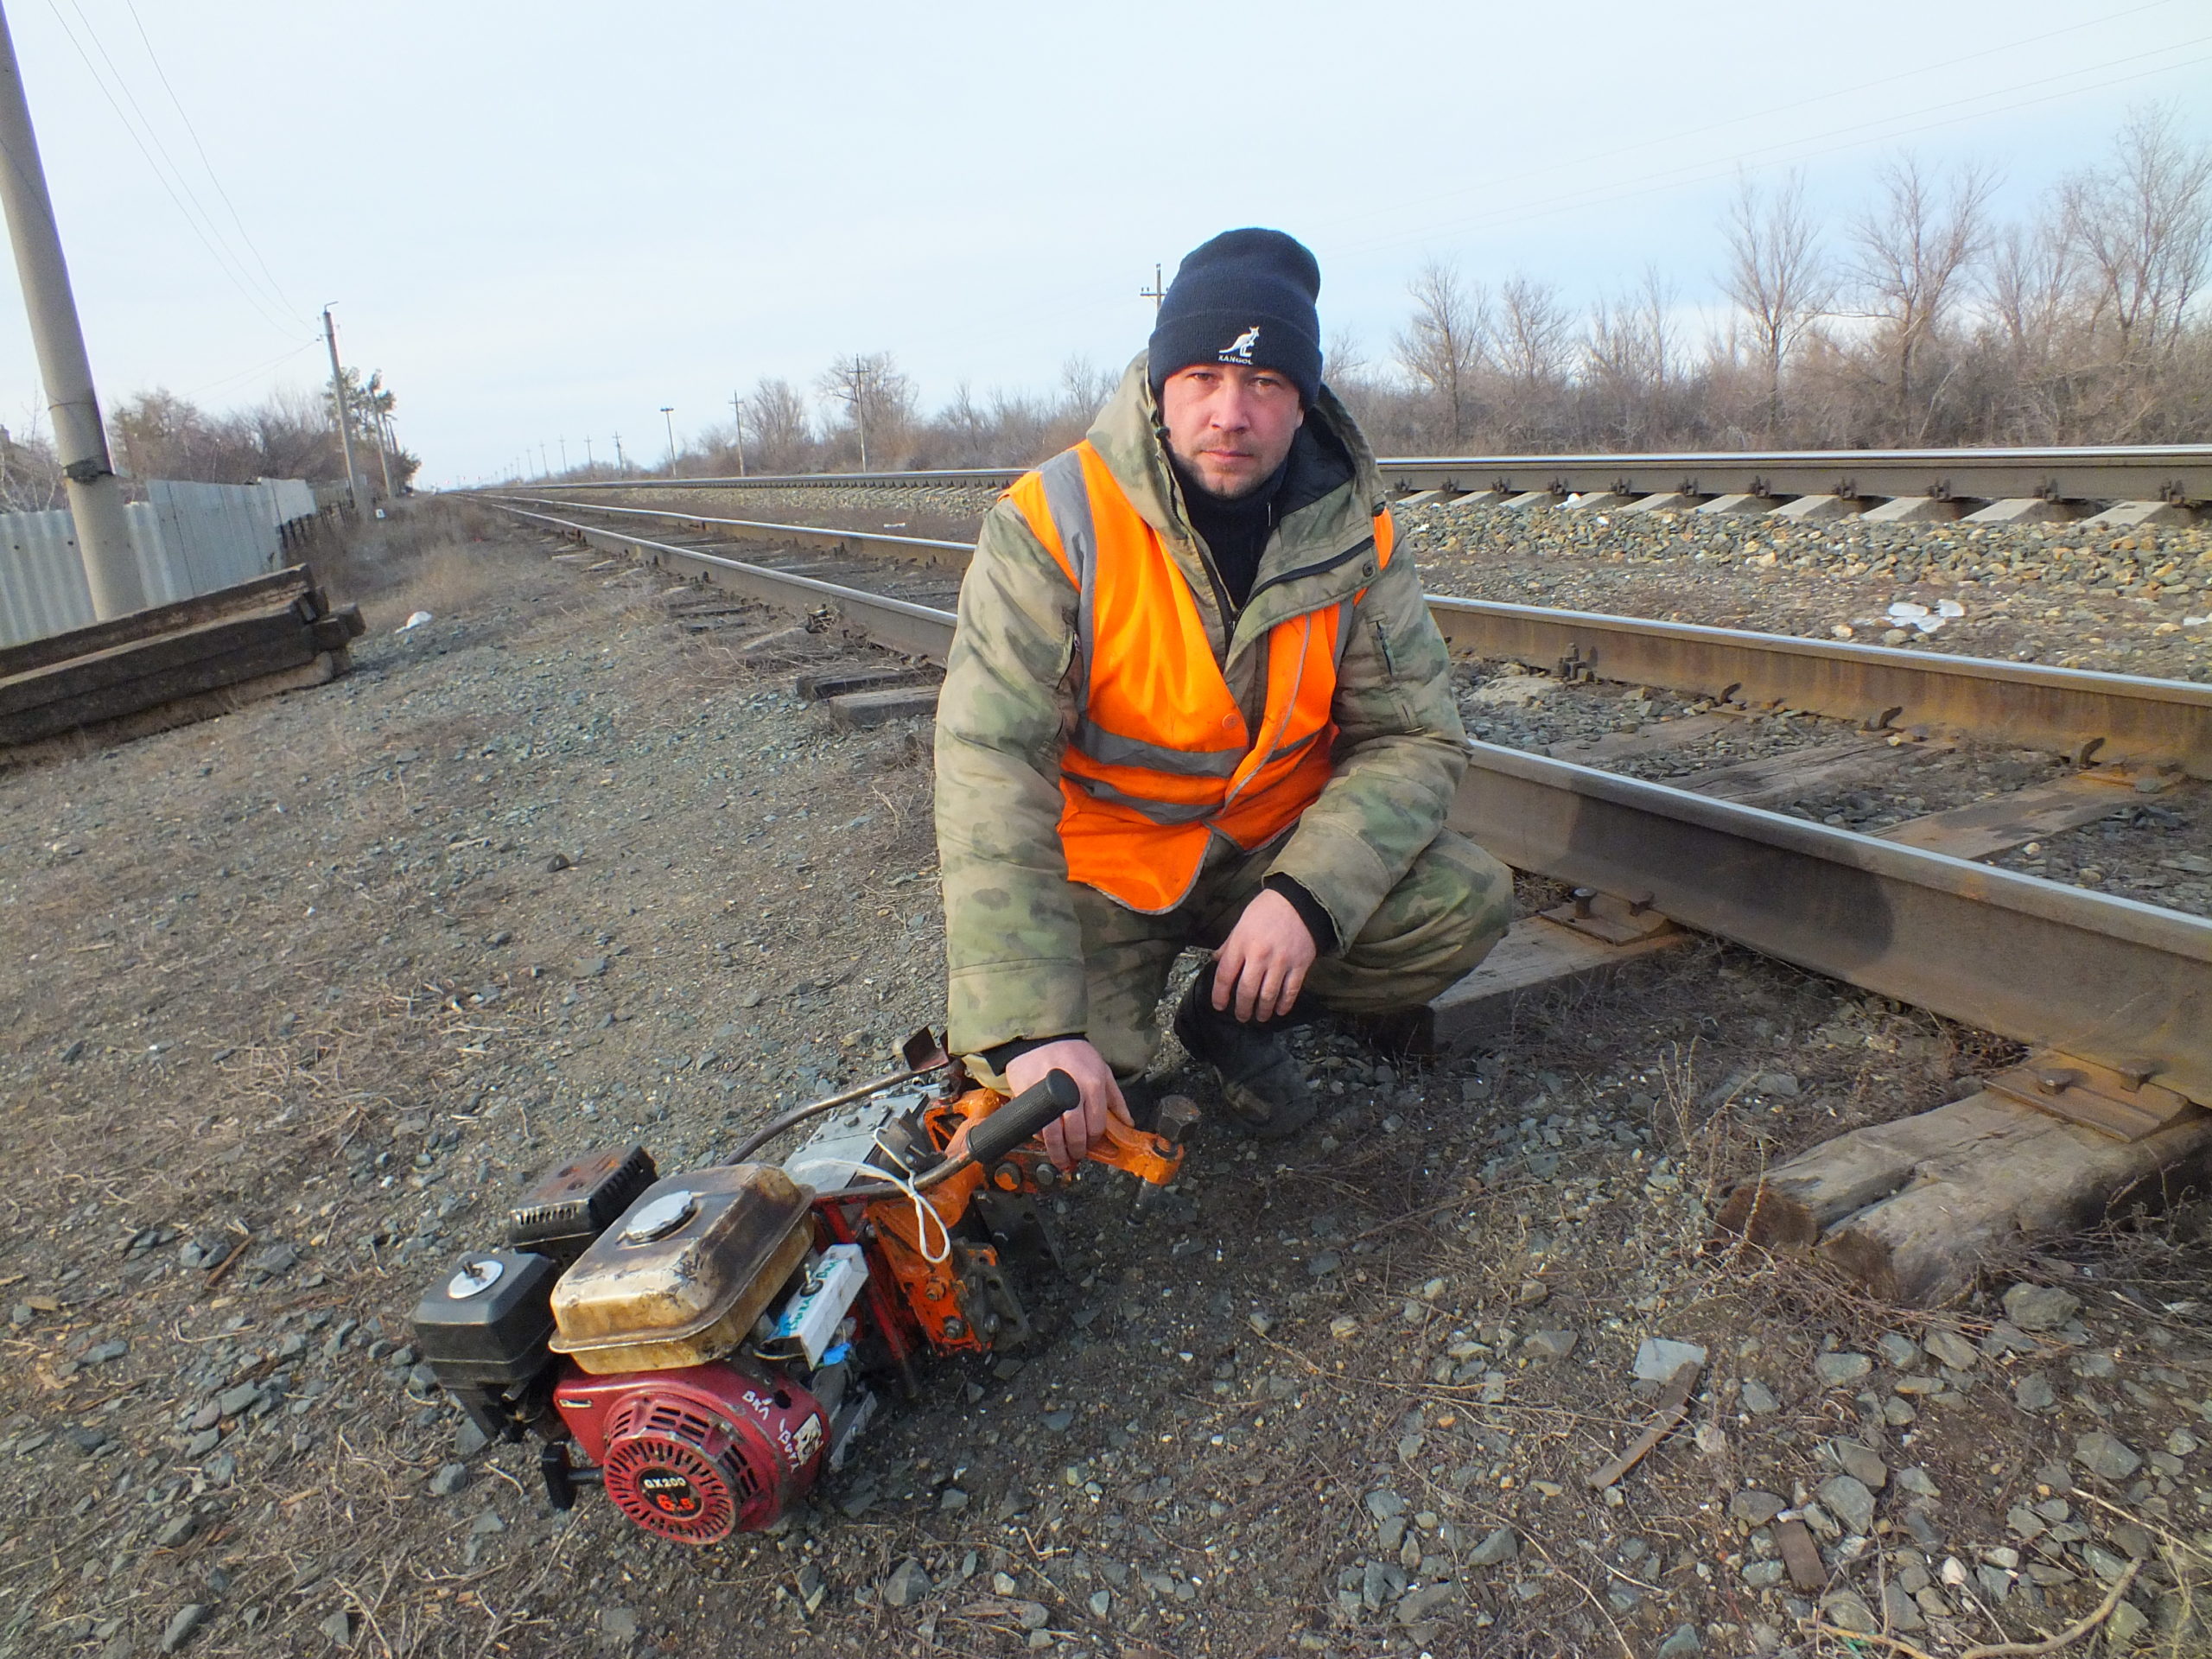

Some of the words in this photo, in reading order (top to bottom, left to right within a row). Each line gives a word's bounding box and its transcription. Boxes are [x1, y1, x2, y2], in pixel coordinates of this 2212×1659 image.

[1218, 354, 1254, 365] KANGOL
[643, 1477, 688, 1490] GX200
[656, 1493, 696, 1513] 6.5
